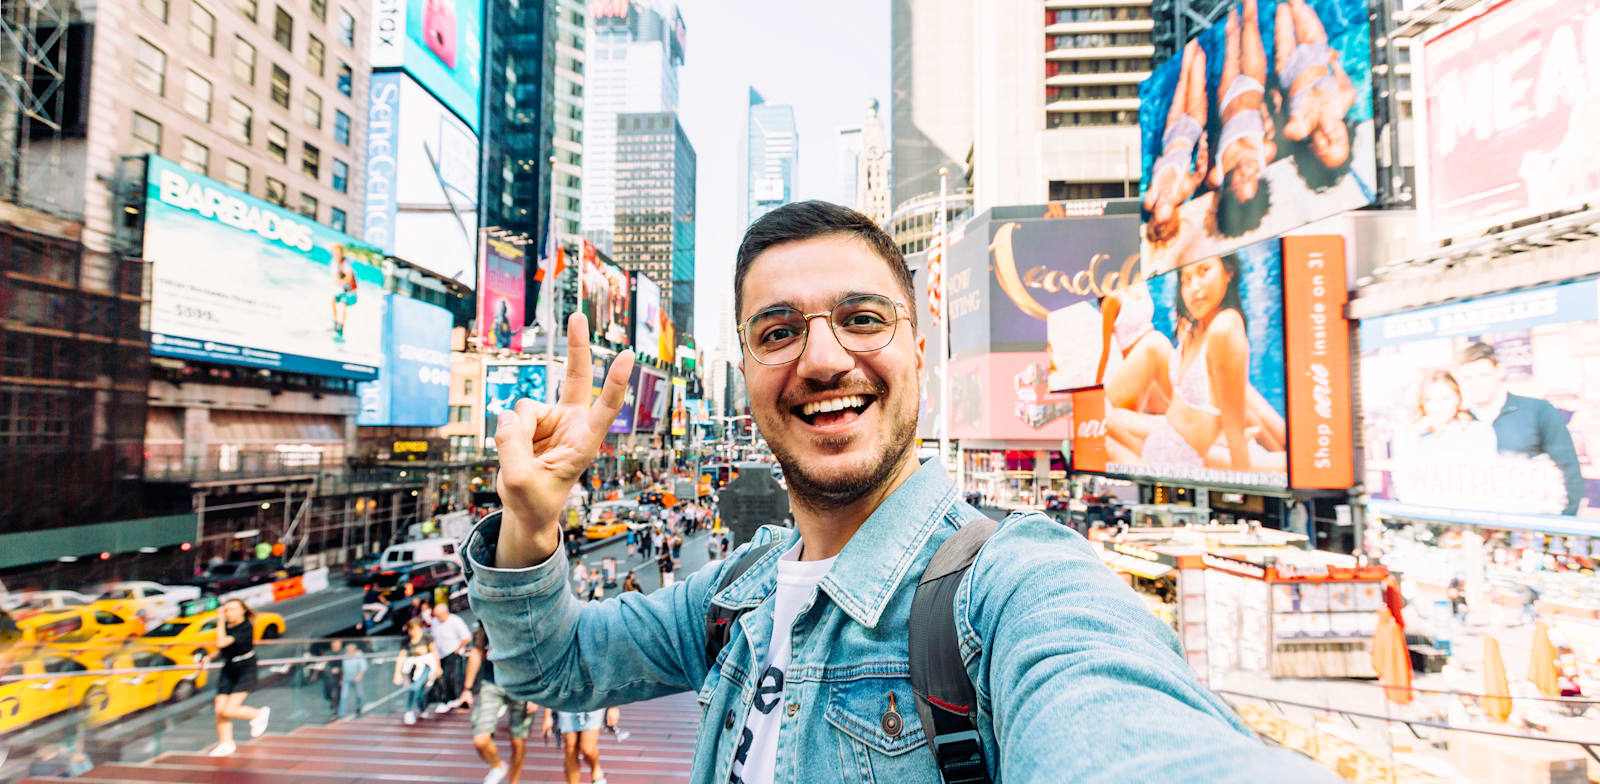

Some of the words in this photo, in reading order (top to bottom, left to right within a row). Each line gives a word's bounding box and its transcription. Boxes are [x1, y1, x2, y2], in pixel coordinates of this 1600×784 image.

[161, 170, 314, 251] BARBADOS
[1312, 275, 1326, 297] on
[1309, 303, 1328, 356] inside
[1305, 363, 1332, 419] aerie
[1314, 424, 1334, 469] Shop
